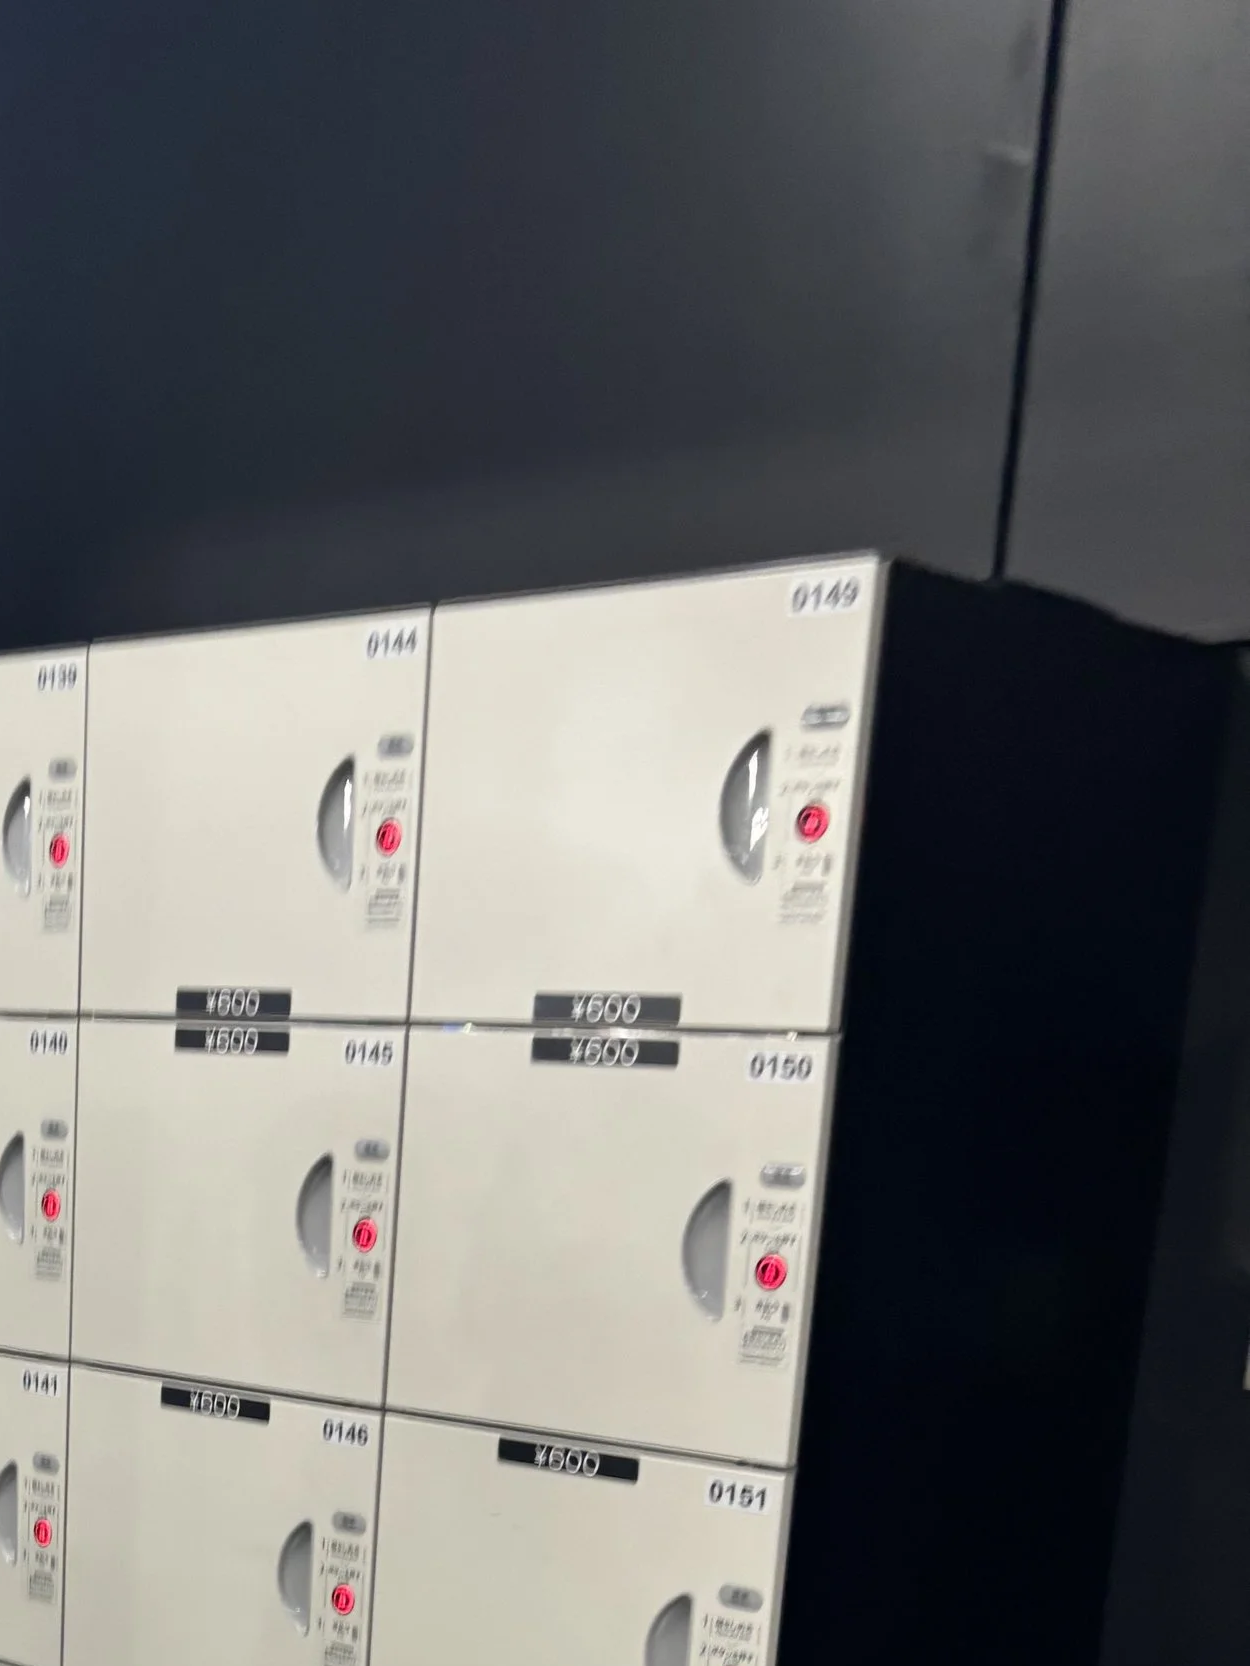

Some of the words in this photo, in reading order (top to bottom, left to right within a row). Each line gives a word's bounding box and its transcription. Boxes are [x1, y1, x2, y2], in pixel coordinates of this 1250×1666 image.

[792, 577, 861, 612] 0149
[366, 628, 418, 658] 0144
[206, 988, 260, 1016] ¥600
[571, 993, 641, 1023] ¥600
[30, 1030, 68, 1055] 0140
[206, 1027, 258, 1054] ¥600
[345, 1040, 393, 1065] 0145
[571, 1037, 639, 1066] ¥600
[750, 1052, 813, 1080] 0150
[23, 1370, 58, 1395] 0141
[190, 1388, 240, 1419] ¥600
[323, 1418, 369, 1445] 0146
[534, 1446, 600, 1477] ¥600
[709, 1479, 768, 1510] 0151
